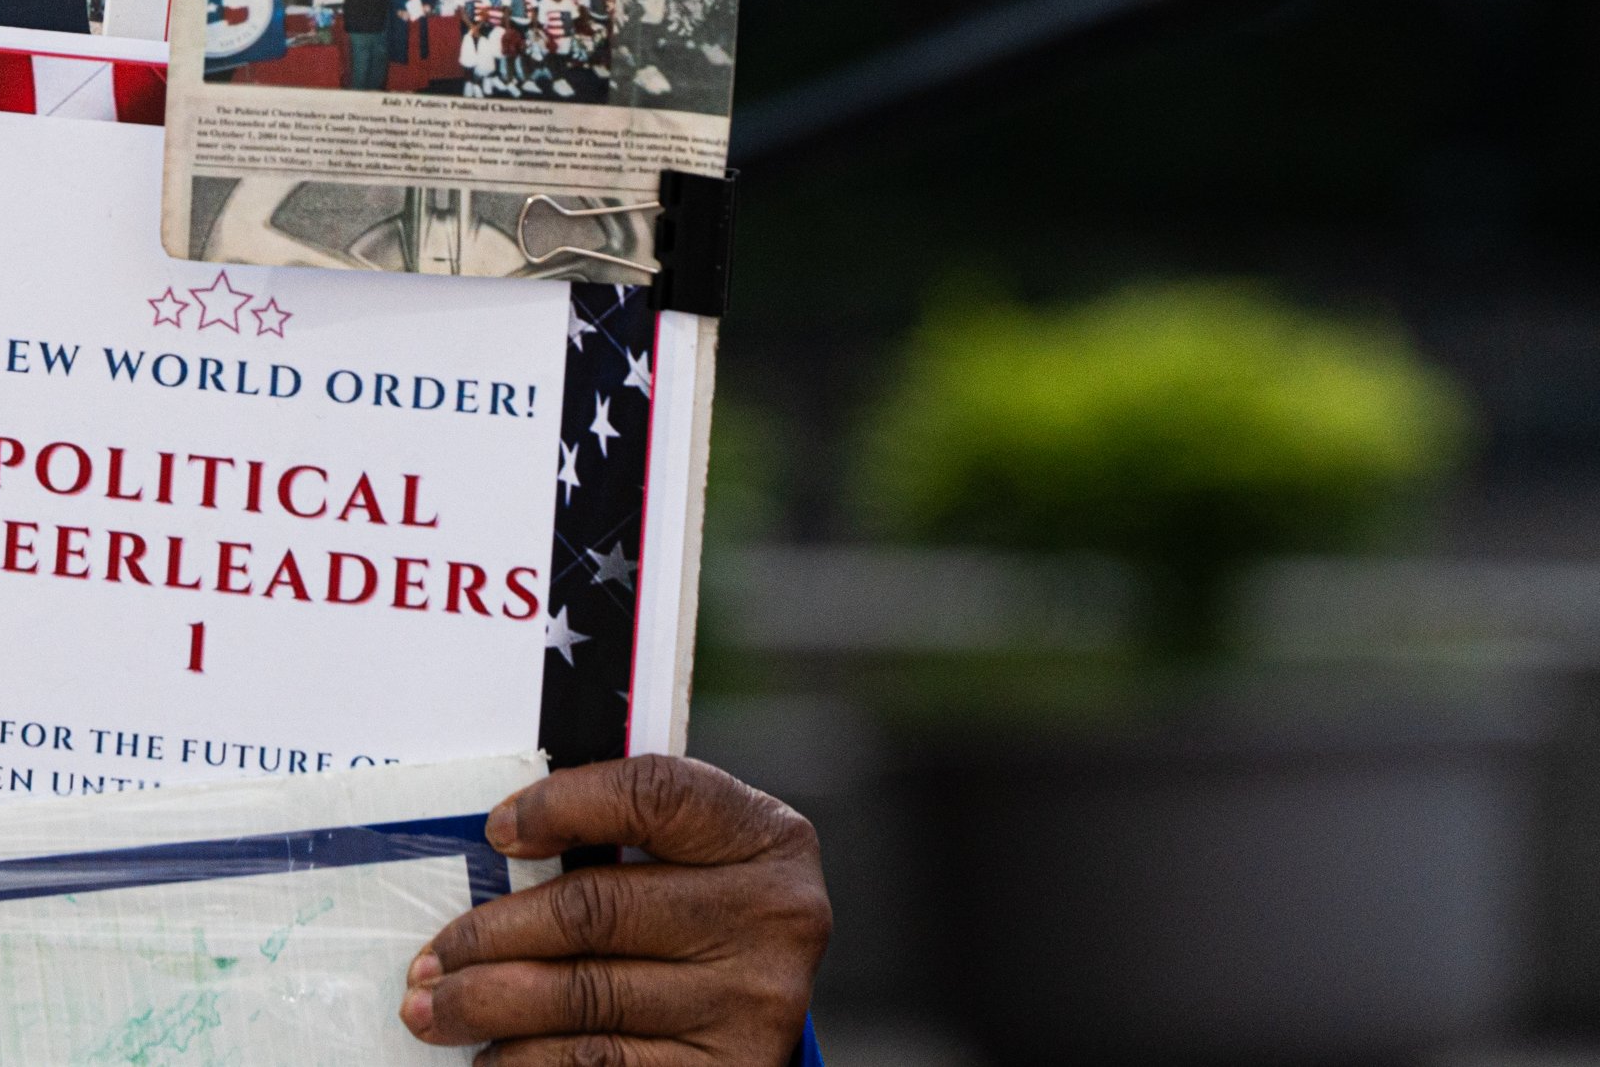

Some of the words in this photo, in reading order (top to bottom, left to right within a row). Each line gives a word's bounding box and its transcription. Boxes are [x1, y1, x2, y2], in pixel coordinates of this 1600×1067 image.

[102, 346, 302, 400] WORLD
[325, 368, 538, 419] ORDER!
[186, 620, 206, 673] 1
[0, 720, 74, 752] FOR
[90, 728, 165, 761] THE
